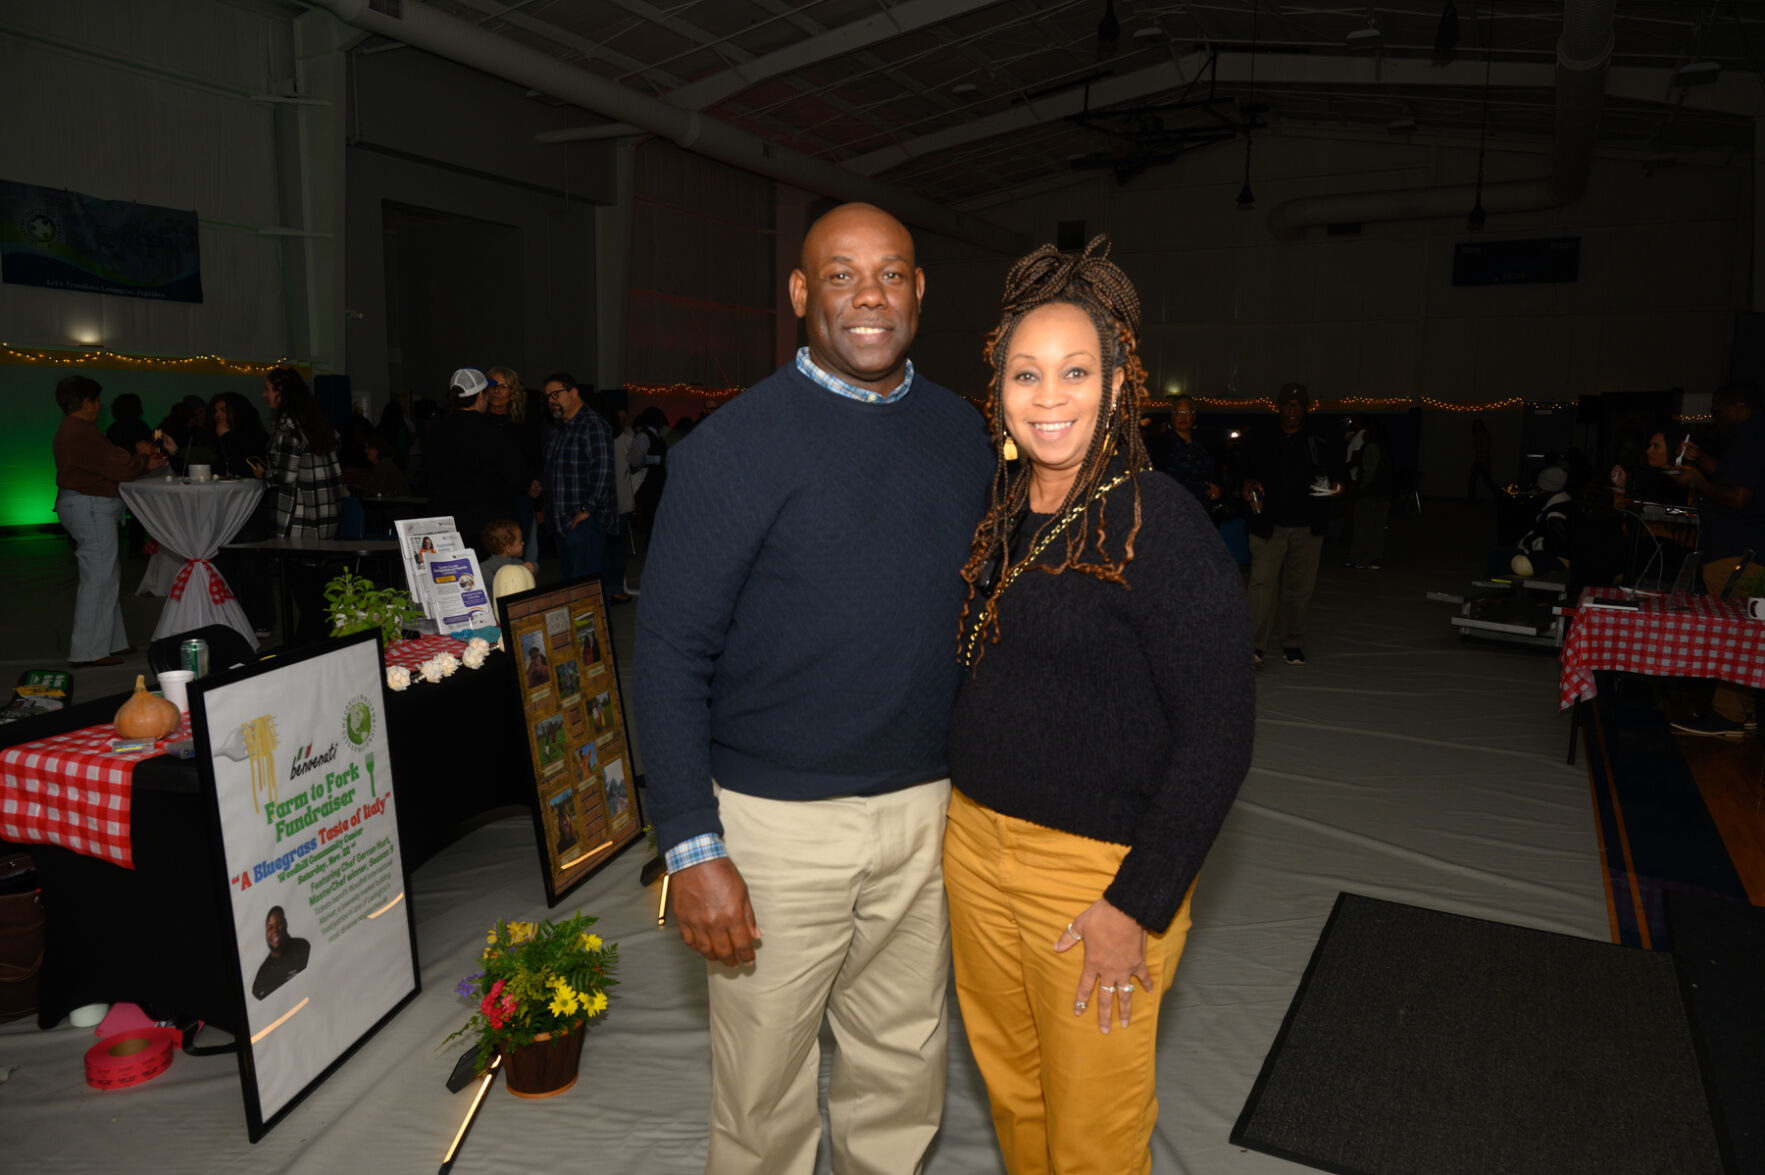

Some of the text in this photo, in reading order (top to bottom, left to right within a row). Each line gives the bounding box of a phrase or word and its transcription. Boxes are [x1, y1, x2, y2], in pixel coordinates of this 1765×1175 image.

[264, 762, 359, 823] Farm to Fork
[276, 789, 354, 841] Fundraiser
[253, 838, 316, 881] Bluegrass
[318, 819, 348, 844] Taste
[350, 807, 360, 826] of
[277, 827, 363, 882] Woodhill Community Center
[309, 874, 345, 905] MasterChef
[368, 849, 389, 866] Season
[310, 868, 340, 890] Featuring
[341, 855, 355, 871] Chef
